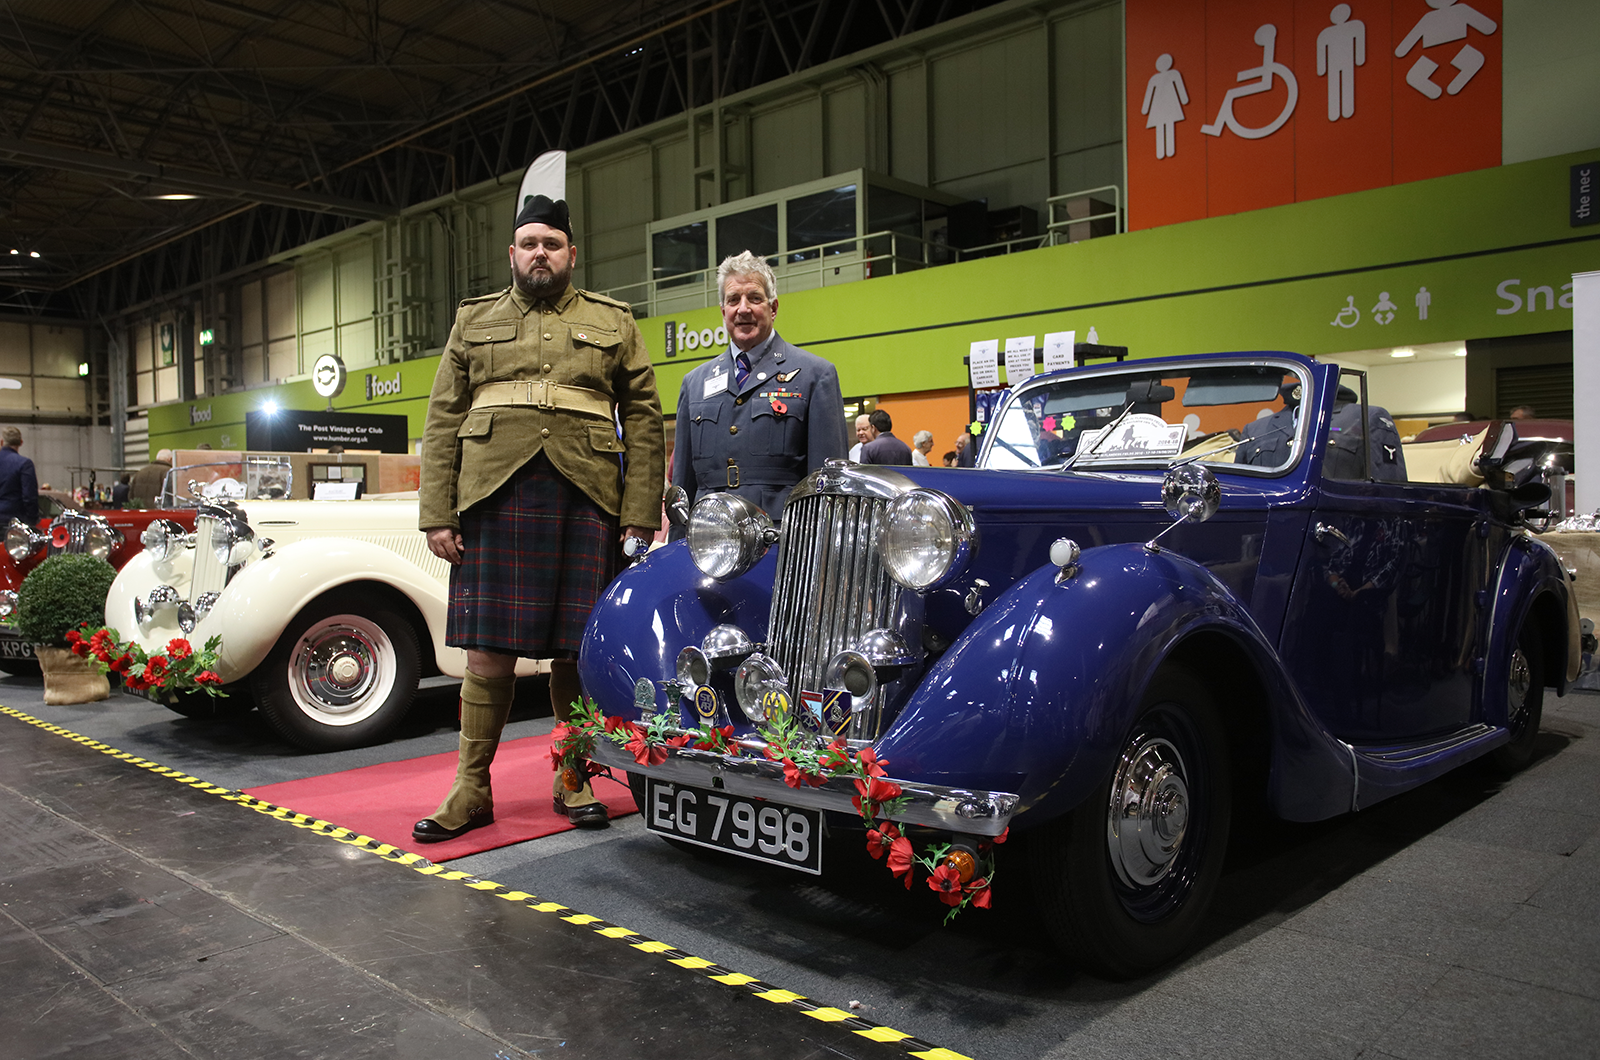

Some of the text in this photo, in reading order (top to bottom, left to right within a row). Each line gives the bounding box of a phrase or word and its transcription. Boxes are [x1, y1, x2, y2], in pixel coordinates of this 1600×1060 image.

[1576, 169, 1590, 219] the nec
[676, 318, 728, 350] food
[372, 372, 400, 396] food
[192, 404, 212, 423] food
[313, 435, 368, 443] www.humber.org.uk
[330, 425, 354, 434] Vintage
[1, 641, 31, 657] KPG
[654, 784, 810, 862] EG 7998
